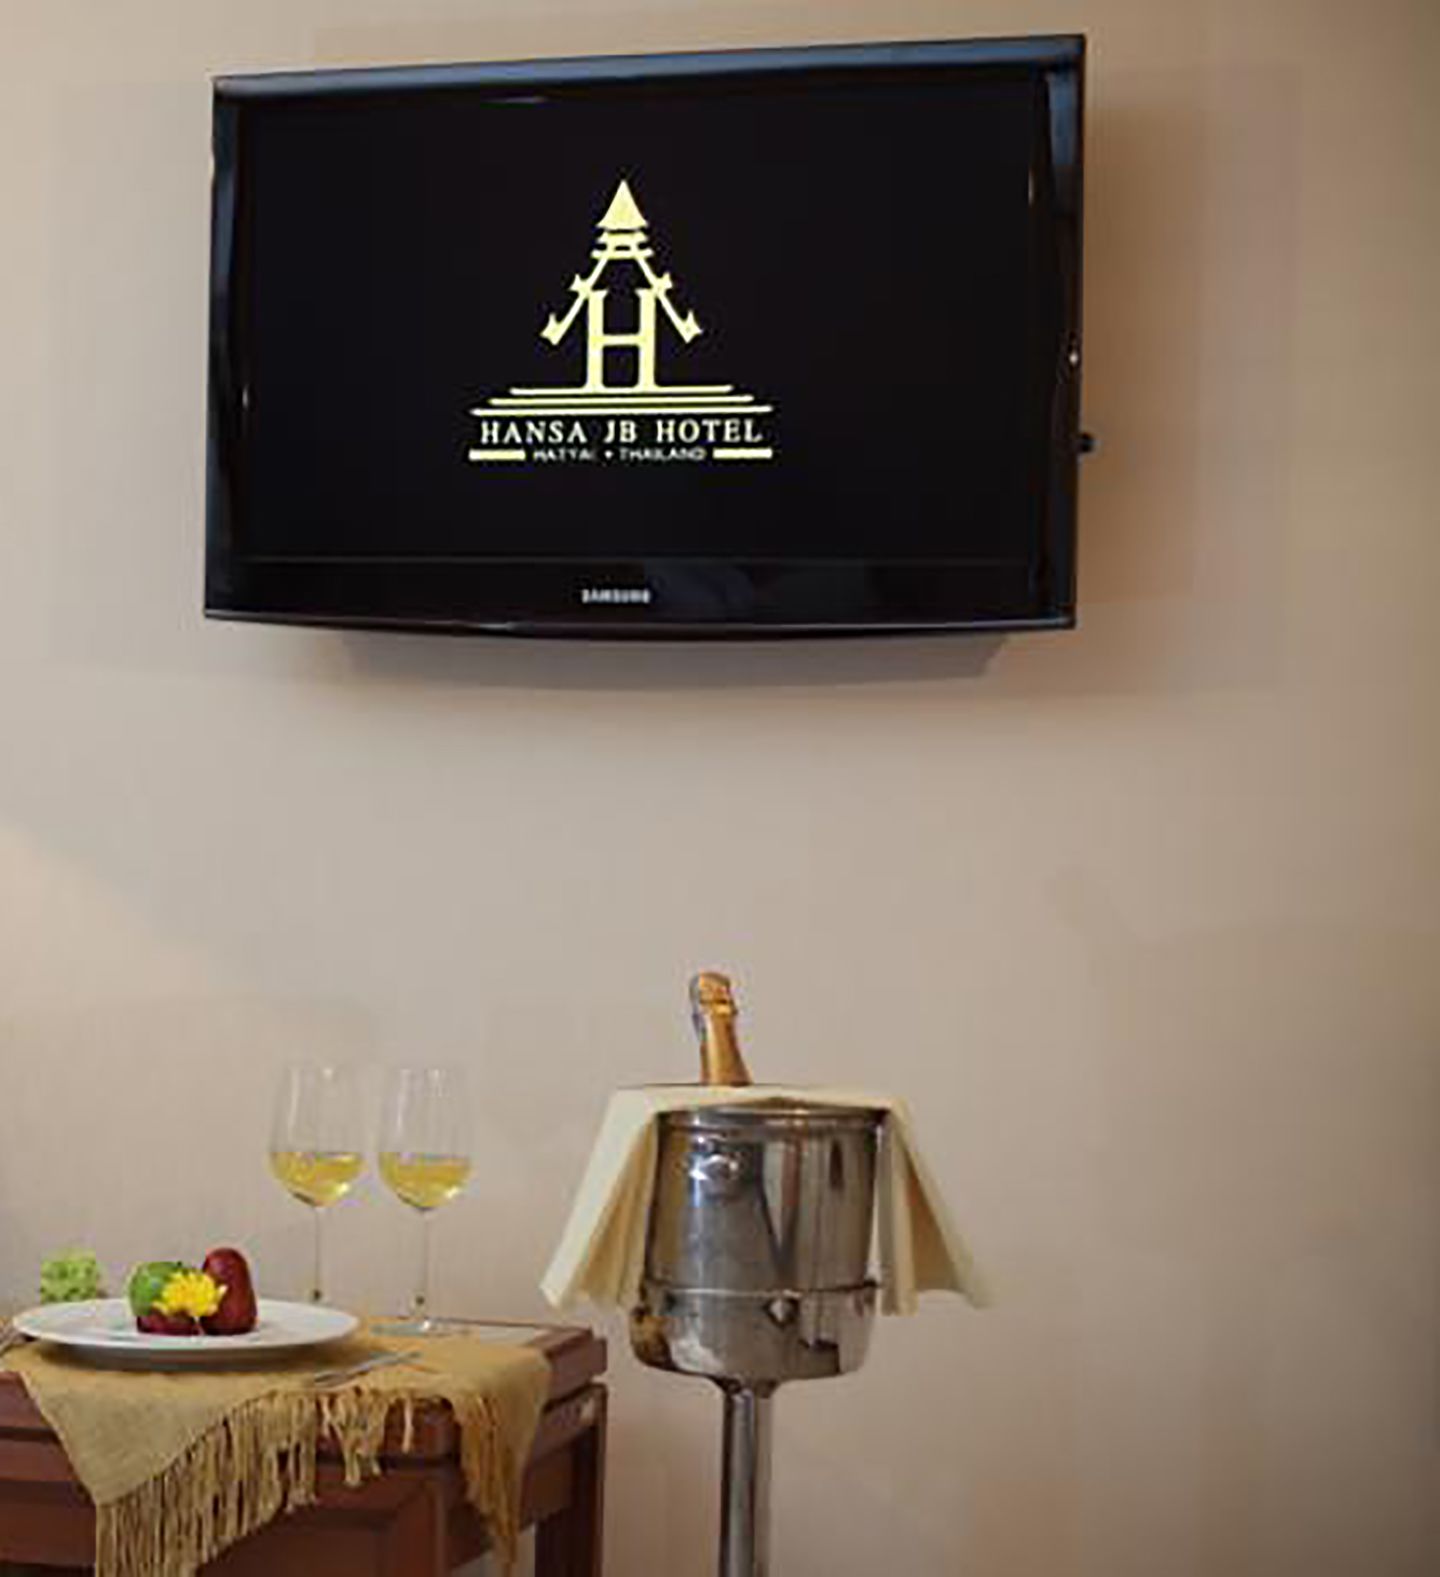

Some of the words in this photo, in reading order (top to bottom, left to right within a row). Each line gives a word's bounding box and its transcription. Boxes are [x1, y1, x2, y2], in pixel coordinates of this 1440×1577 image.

[480, 419, 588, 444] HANSA
[603, 419, 637, 443] JB
[656, 417, 762, 443] HOTEL
[581, 587, 651, 603] SAMSUNG
